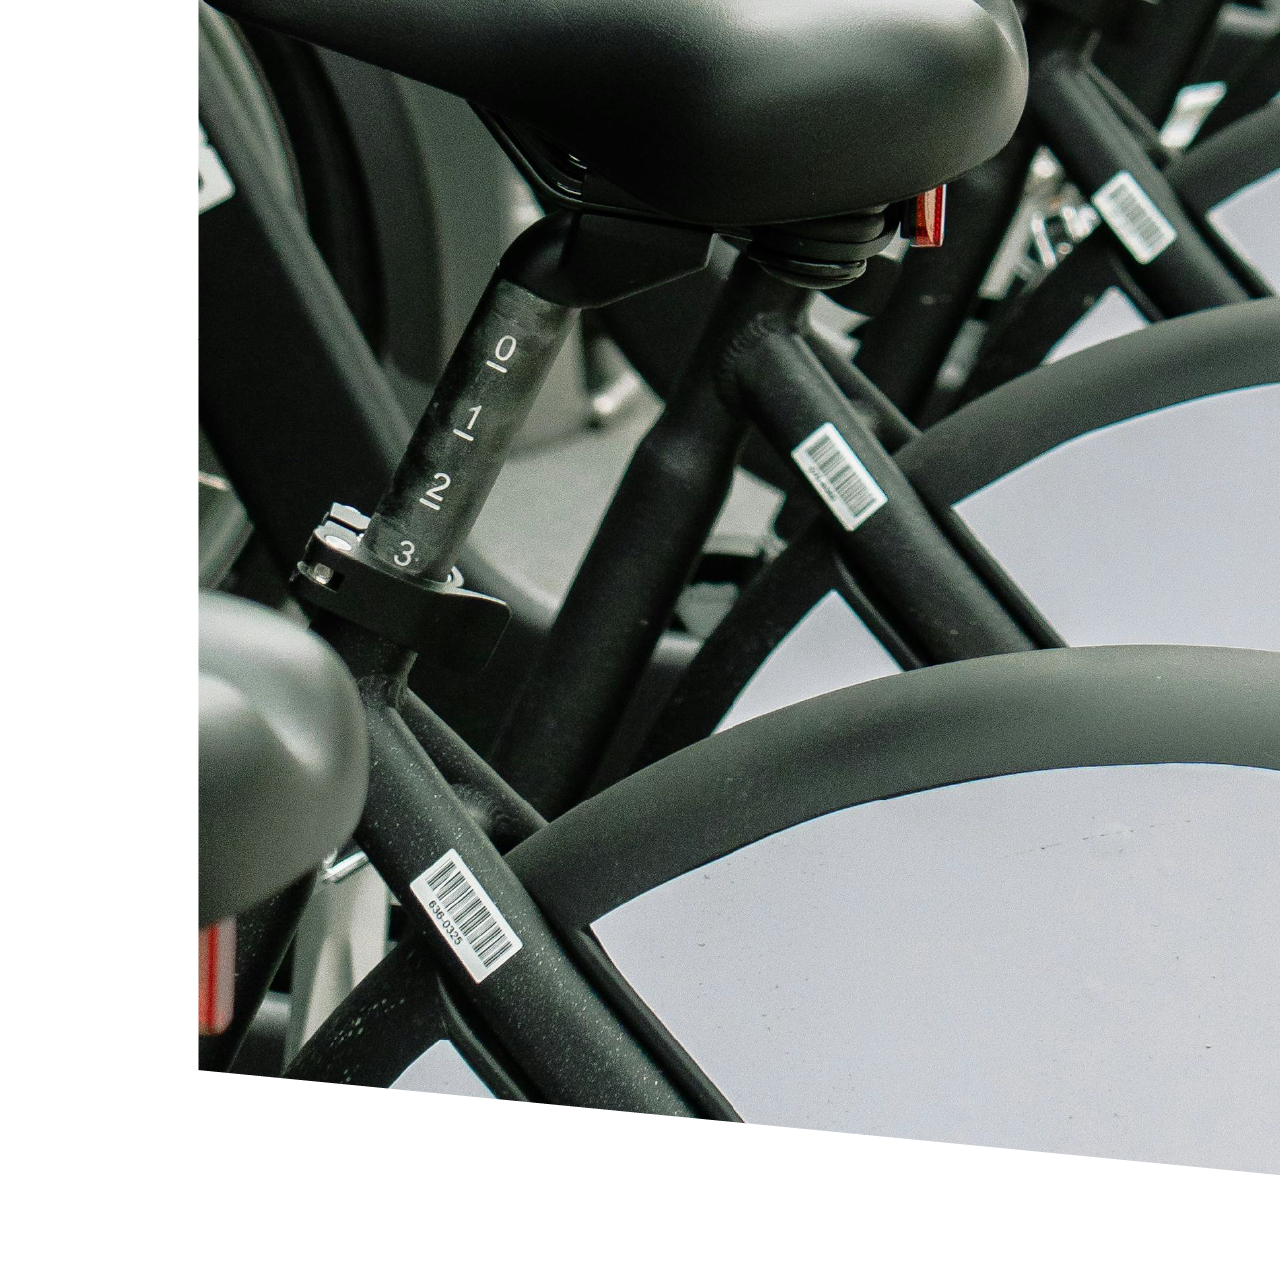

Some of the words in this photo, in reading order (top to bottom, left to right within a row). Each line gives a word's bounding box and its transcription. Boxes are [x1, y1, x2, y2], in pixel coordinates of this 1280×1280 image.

[494, 335, 517, 361] 0
[466, 405, 484, 430] 1
[425, 472, 451, 502] 2
[393, 540, 416, 567] 3
[428, 900, 462, 946] 636-0325
